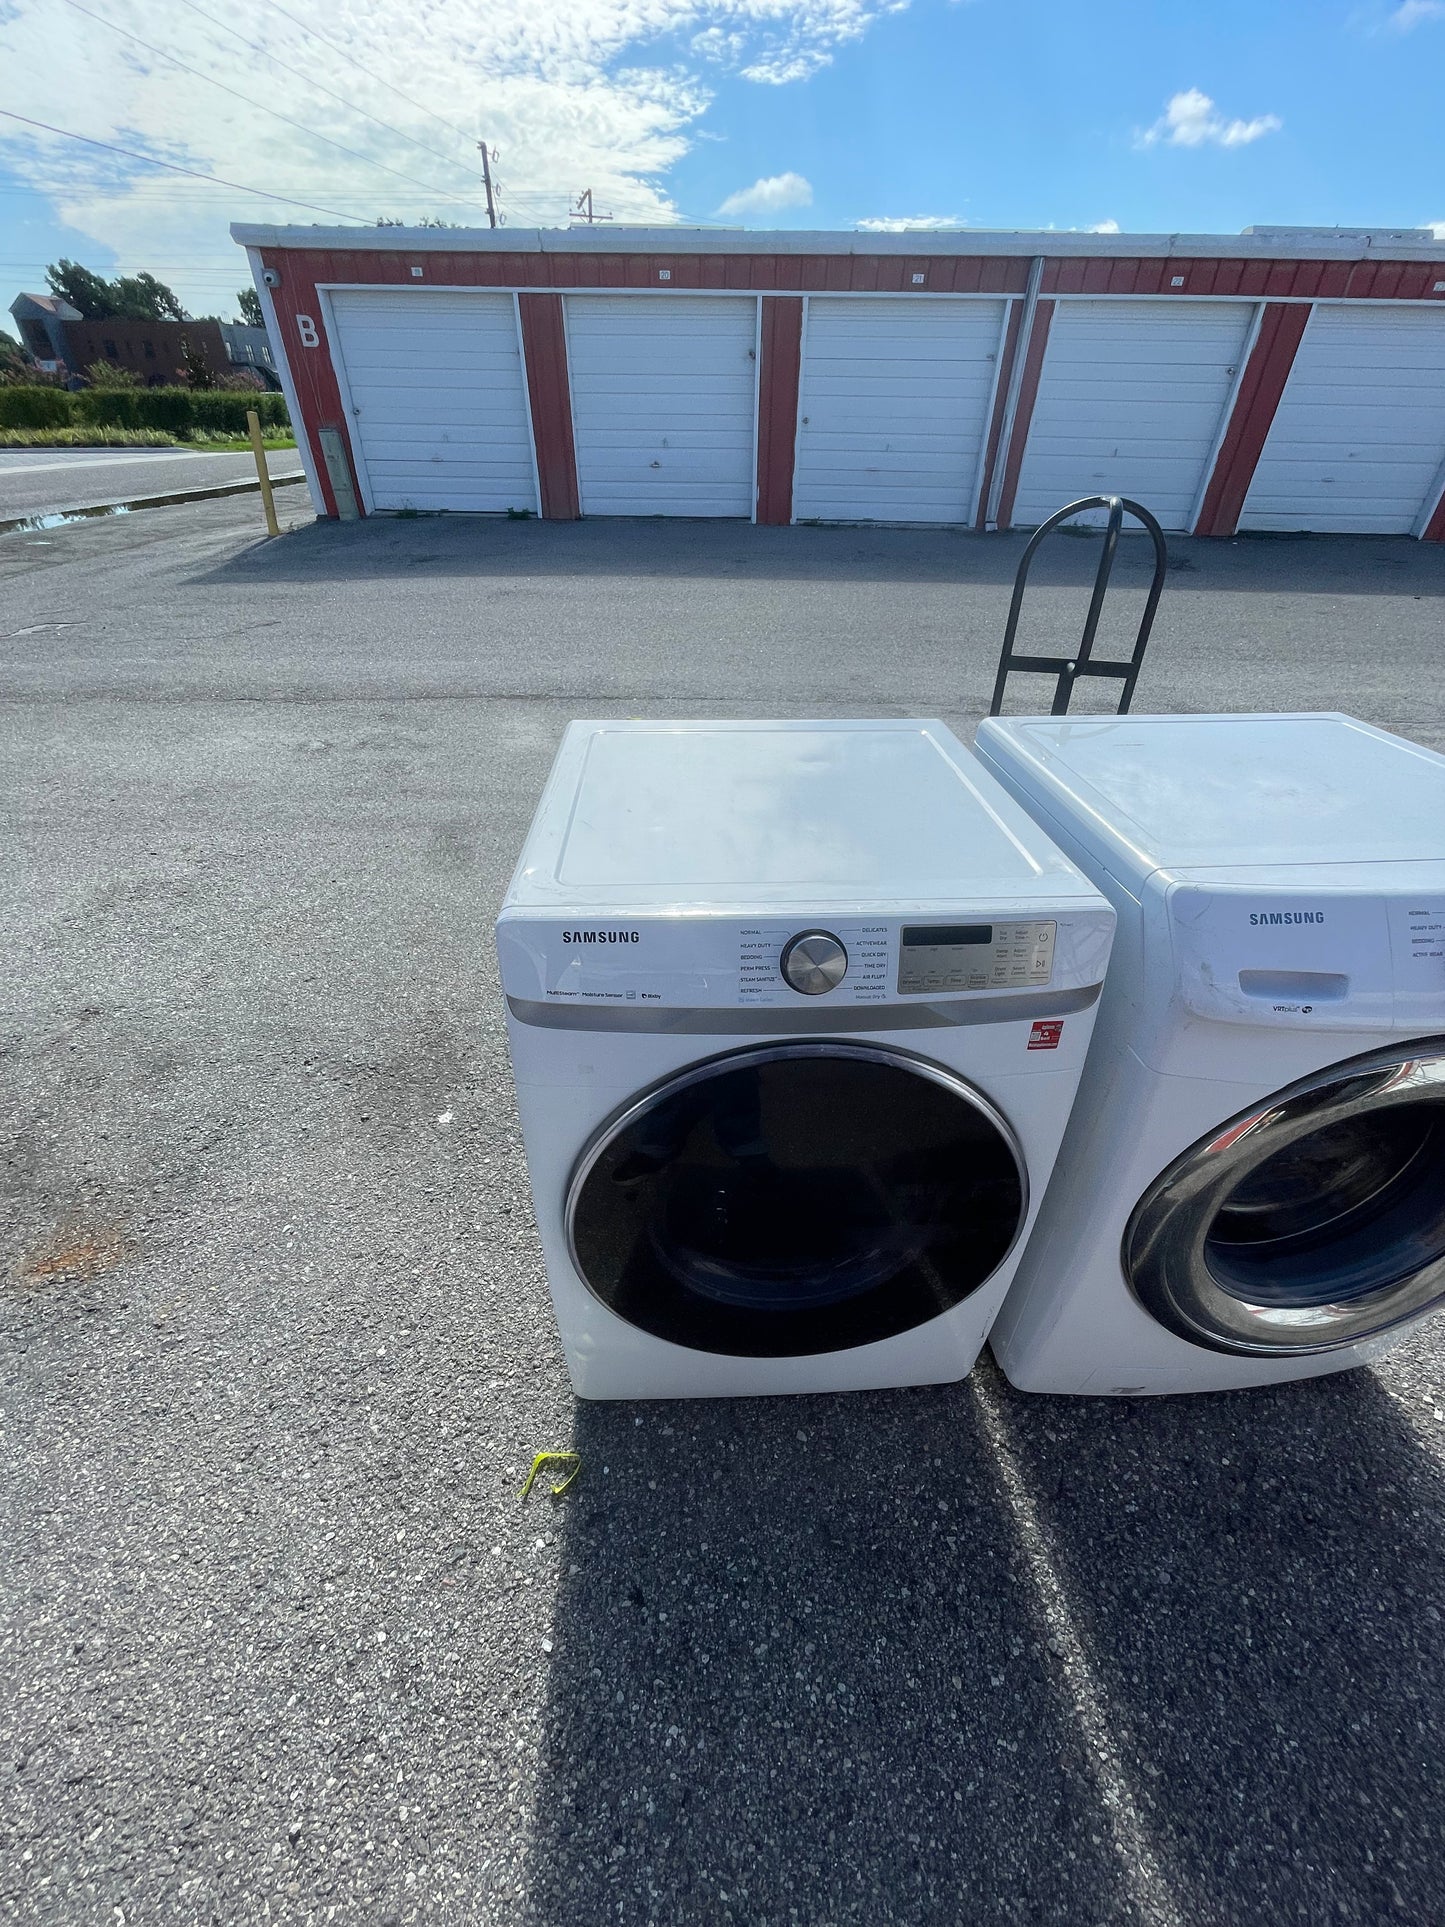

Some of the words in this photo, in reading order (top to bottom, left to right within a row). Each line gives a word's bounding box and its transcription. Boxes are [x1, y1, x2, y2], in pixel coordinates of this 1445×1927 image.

[296, 314, 320, 349] B
[1249, 911, 1325, 926] SAMSUNG
[562, 931, 640, 944] SAMSUNG
